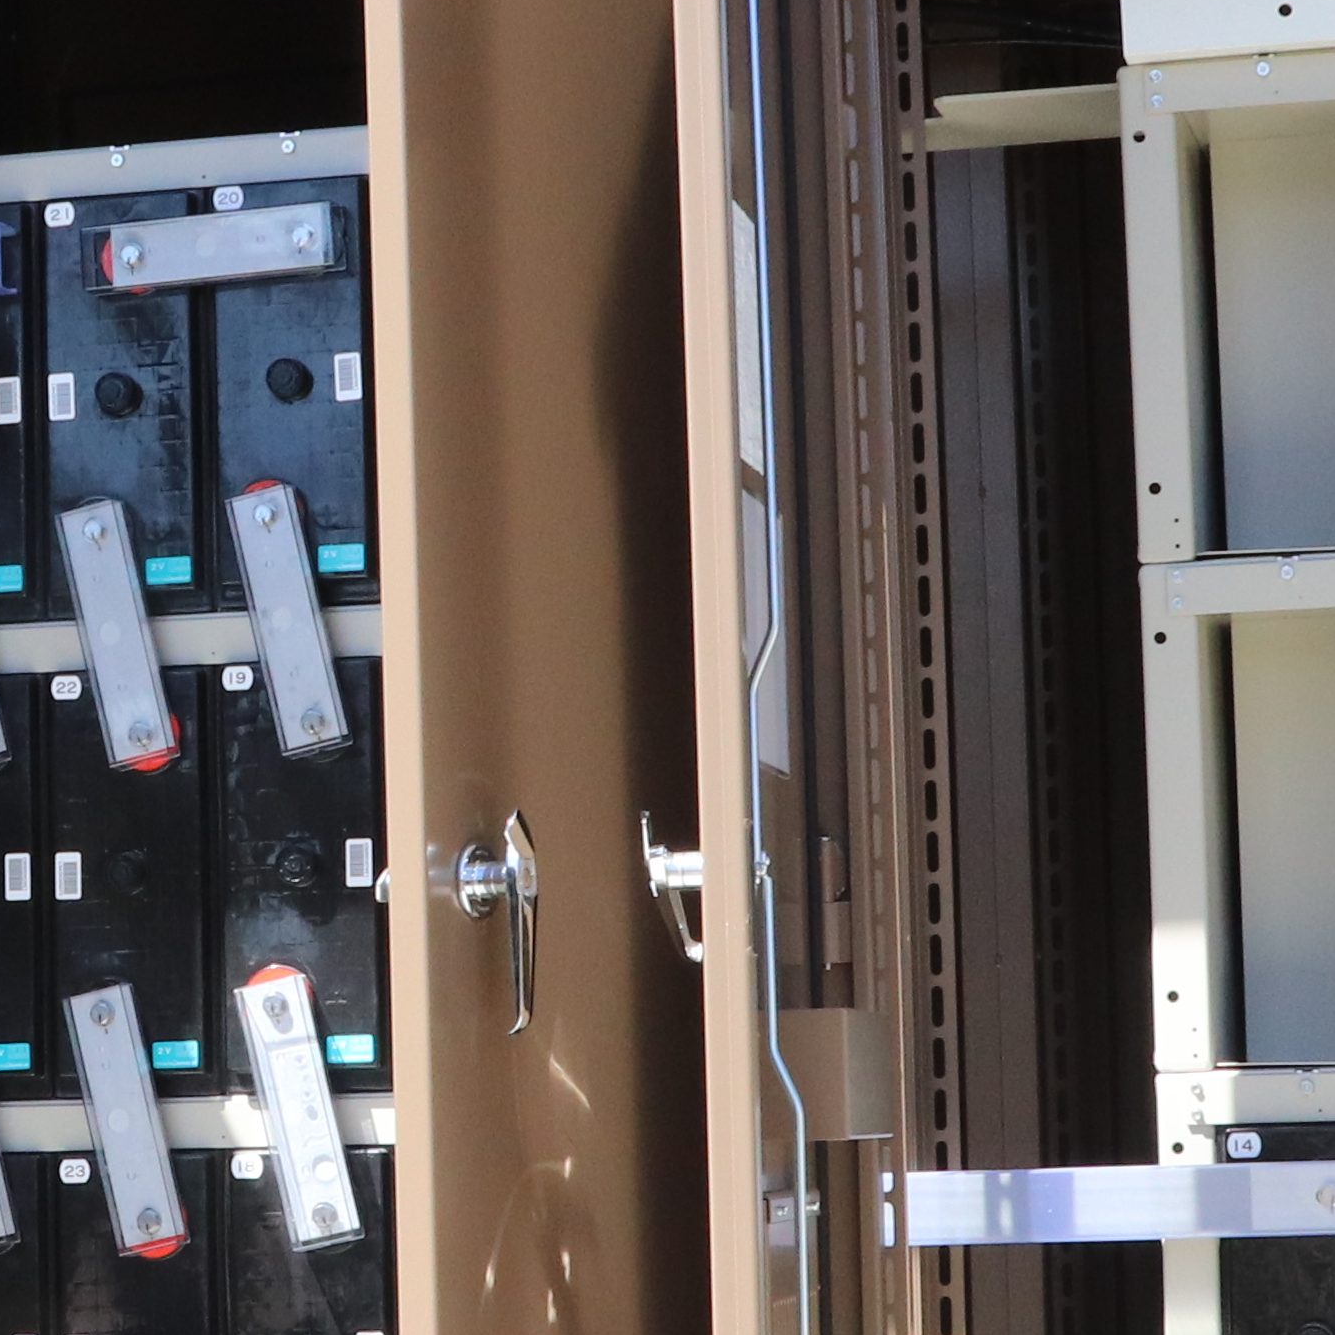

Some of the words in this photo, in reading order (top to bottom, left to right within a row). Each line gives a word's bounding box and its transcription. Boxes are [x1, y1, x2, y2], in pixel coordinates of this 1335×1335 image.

[217, 191, 240, 206] 20
[50, 207, 70, 222] 21
[229, 671, 247, 685] 19
[56, 681, 78, 695] 22
[1234, 1139, 1253, 1152] 14
[64, 1164, 86, 1178] 23
[238, 1160, 255, 1173] 18
